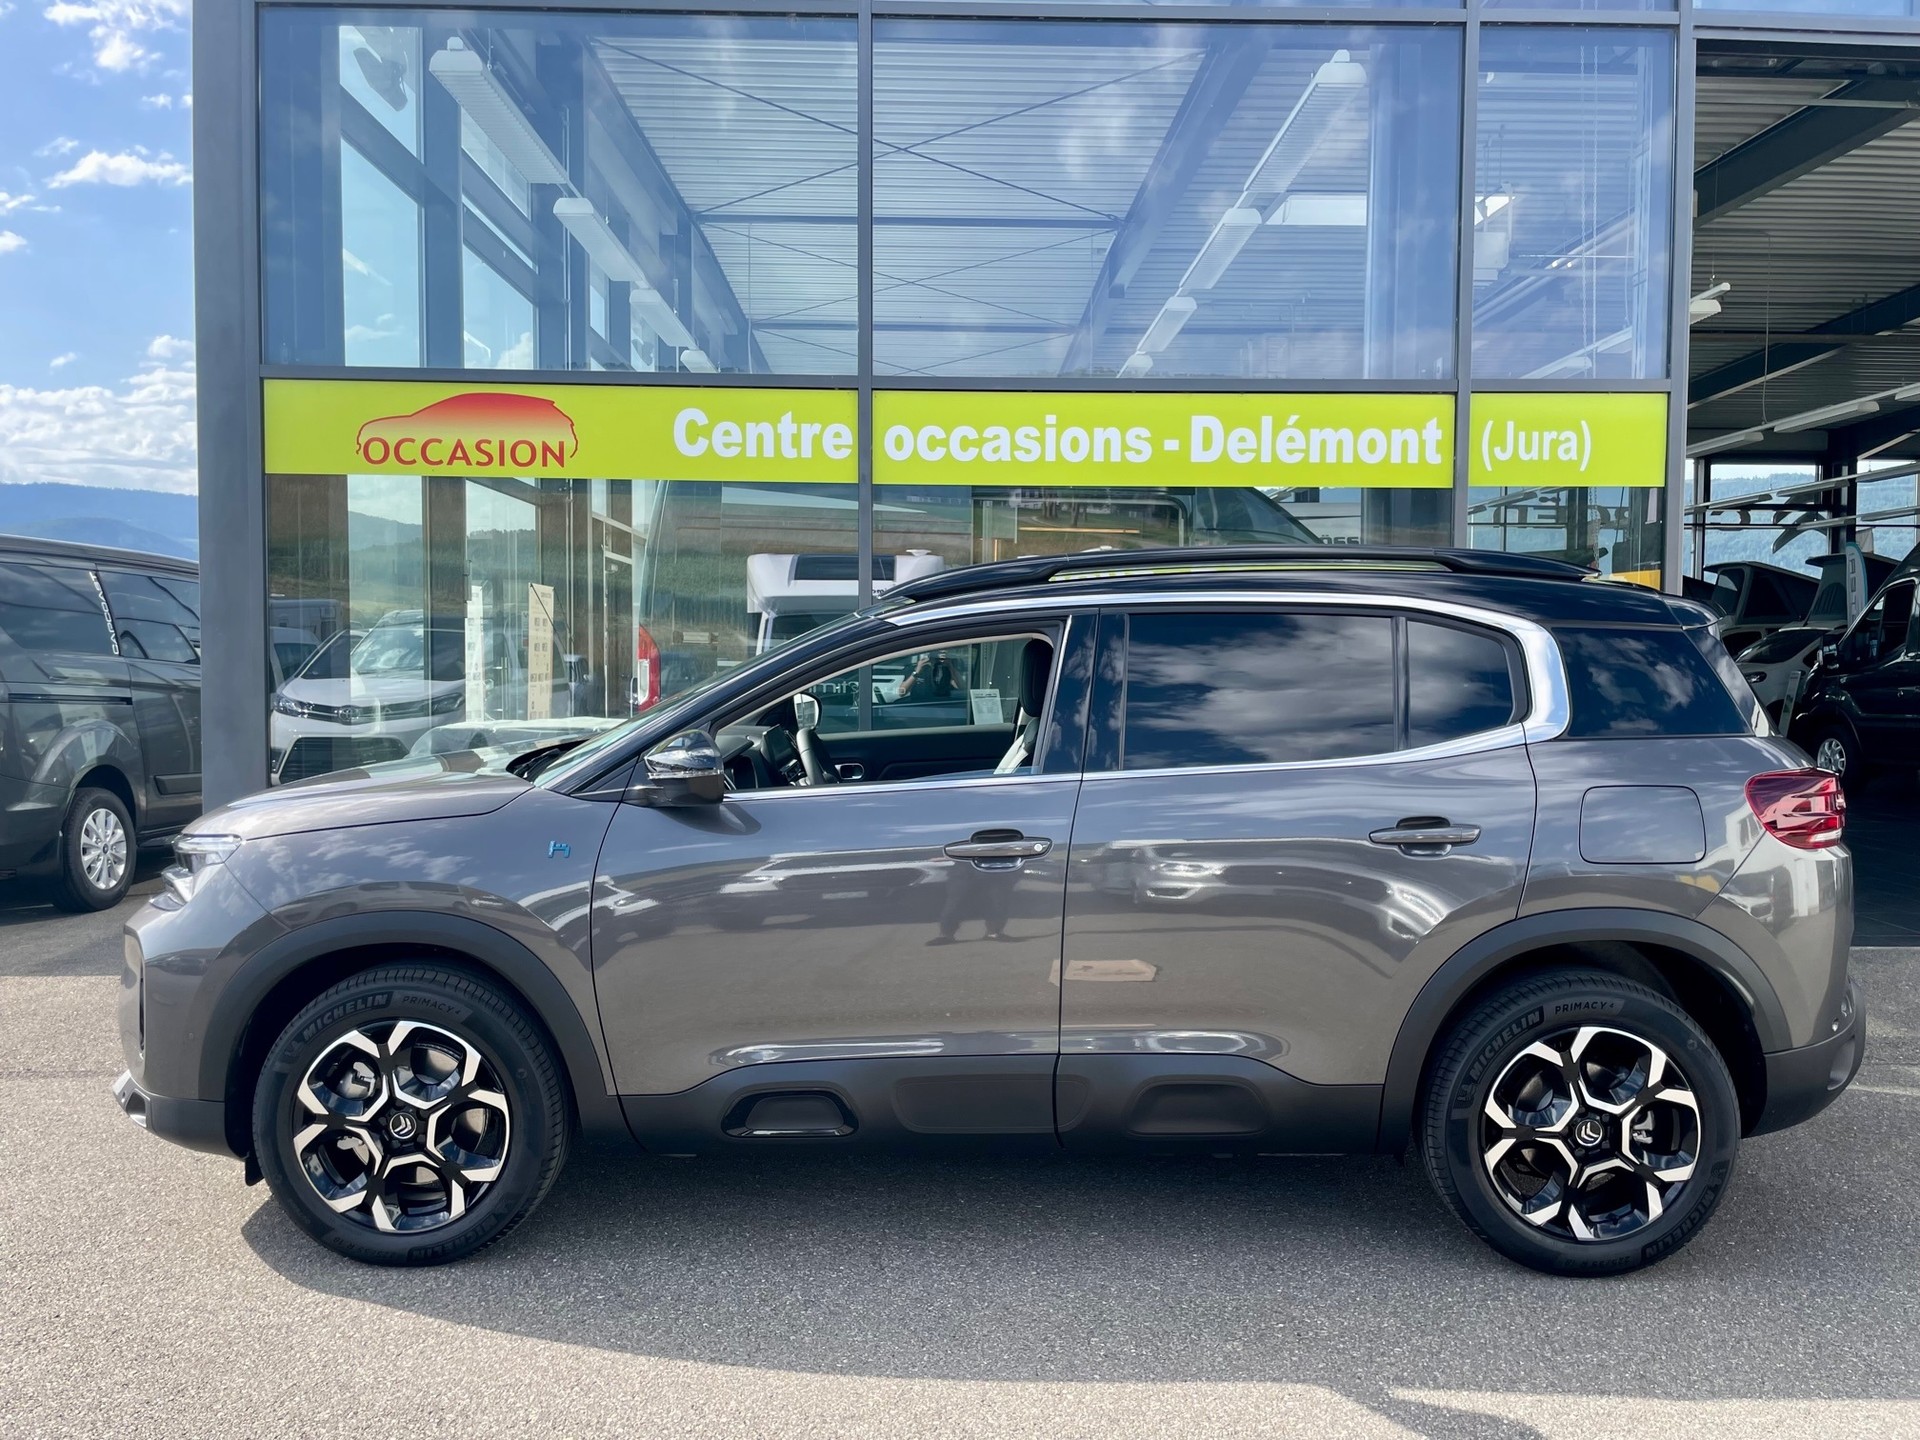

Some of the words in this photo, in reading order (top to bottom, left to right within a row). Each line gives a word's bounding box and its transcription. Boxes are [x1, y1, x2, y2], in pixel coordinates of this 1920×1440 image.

[363, 437, 565, 468] OCCASION
[673, 407, 854, 460] Centre
[883, 414, 1153, 464] occasions
[1189, 414, 1443, 465] Delémont
[1481, 419, 1592, 472] (Jura)
[303, 993, 389, 1041] MICHELIN
[402, 995, 456, 1013] PRIMACY
[1554, 1000, 1607, 1015] PRIMACY
[1469, 1010, 1541, 1081] MICHELIN
